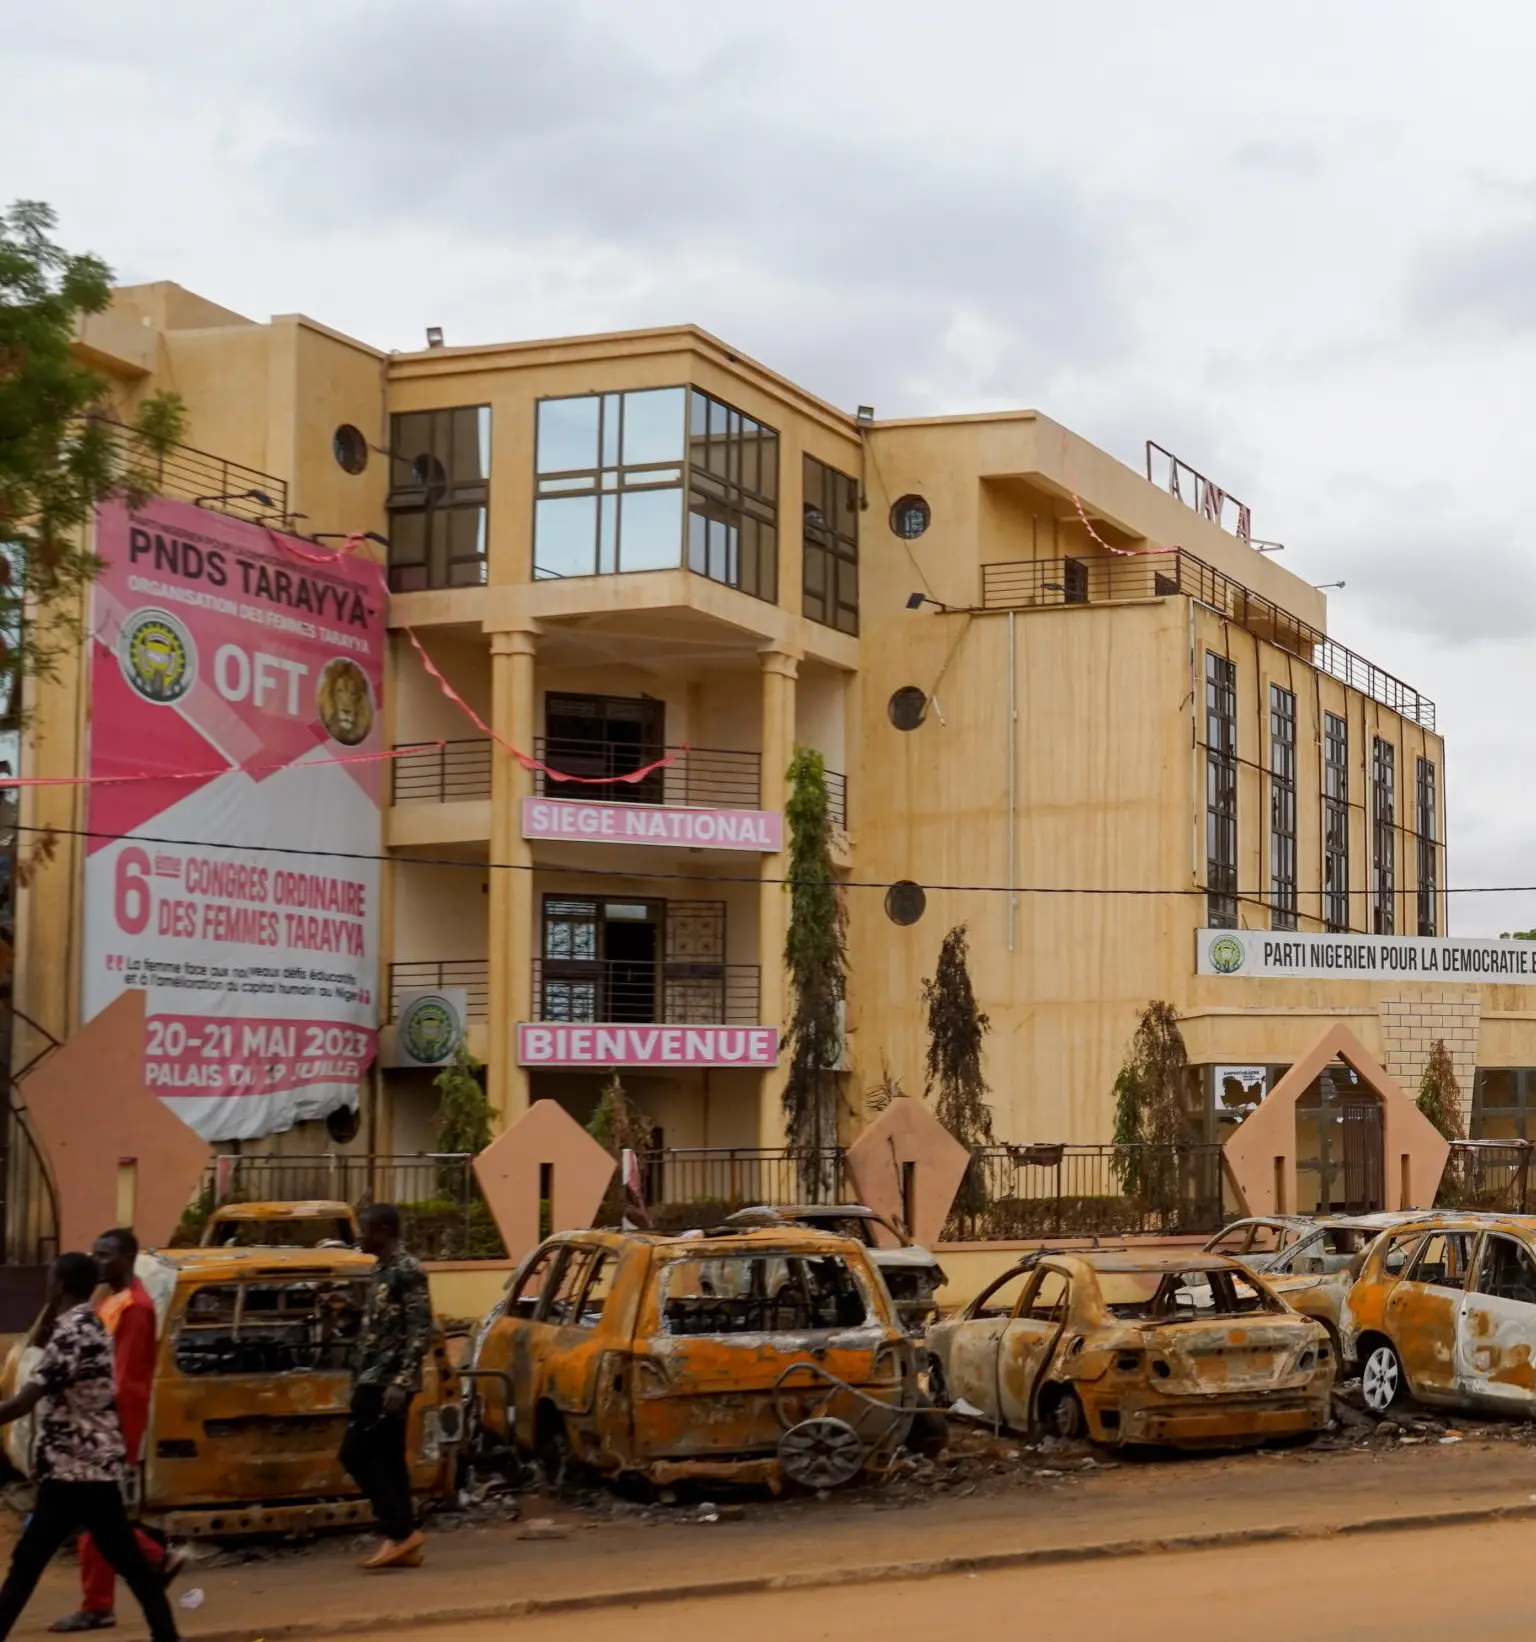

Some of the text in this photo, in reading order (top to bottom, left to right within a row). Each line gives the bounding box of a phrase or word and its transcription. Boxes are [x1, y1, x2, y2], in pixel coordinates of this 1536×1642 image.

[130, 526, 227, 587] PNDS
[236, 558, 369, 630] TARAYYA
[128, 575, 237, 616] ORGANISATION
[267, 612, 316, 639] FEMMES
[318, 626, 370, 655] TARAYYA
[214, 643, 309, 717] OFT
[531, 804, 771, 844] SIEGE NATIONAL
[274, 870, 366, 917] ORDINAIRE
[158, 898, 365, 958] DES FEMMES TARAYYA
[144, 958, 181, 974] femme
[185, 961, 207, 976] face
[1263, 941, 1306, 968] PARTI
[1310, 943, 1376, 970] NIGERIEN
[1380, 945, 1418, 971] POUR
[1421, 947, 1438, 971] LA
[1442, 947, 1528, 974] DEMOCRATIE
[124, 973, 137, 985] et
[241, 980, 275, 995] capital
[279, 982, 317, 997] humain
[145, 1020, 369, 1058] 20-21 MAI 2023
[525, 1028, 770, 1062] BIENVENUE
[145, 1062, 223, 1087] PALAIS
